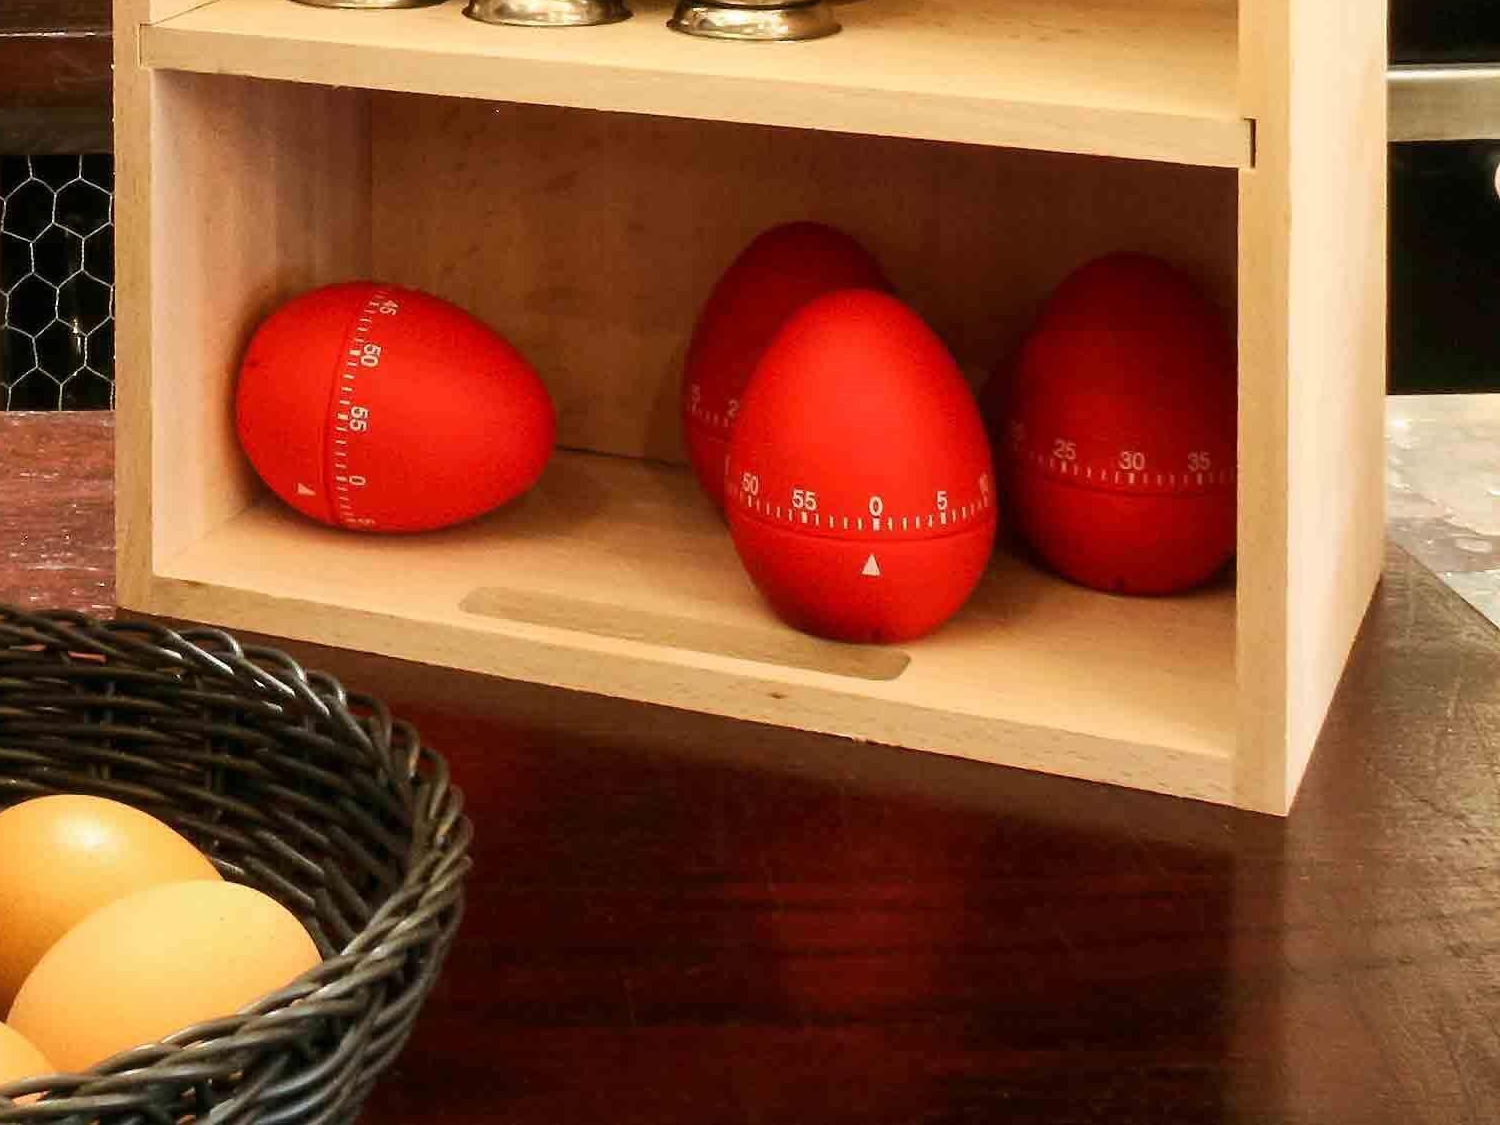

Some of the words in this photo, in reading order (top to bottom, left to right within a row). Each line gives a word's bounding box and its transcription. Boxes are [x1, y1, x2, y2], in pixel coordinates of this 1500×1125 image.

[360, 343, 382, 368] 50
[349, 405, 369, 432] 55
[1053, 439, 1076, 460] 25
[1117, 450, 1146, 472] 30
[1187, 451, 1212, 473] 35
[348, 475, 366, 486] 0
[742, 472, 759, 496] 50
[792, 488, 817, 511] 55
[868, 495, 884, 517] 0
[936, 490, 948, 510] 5
